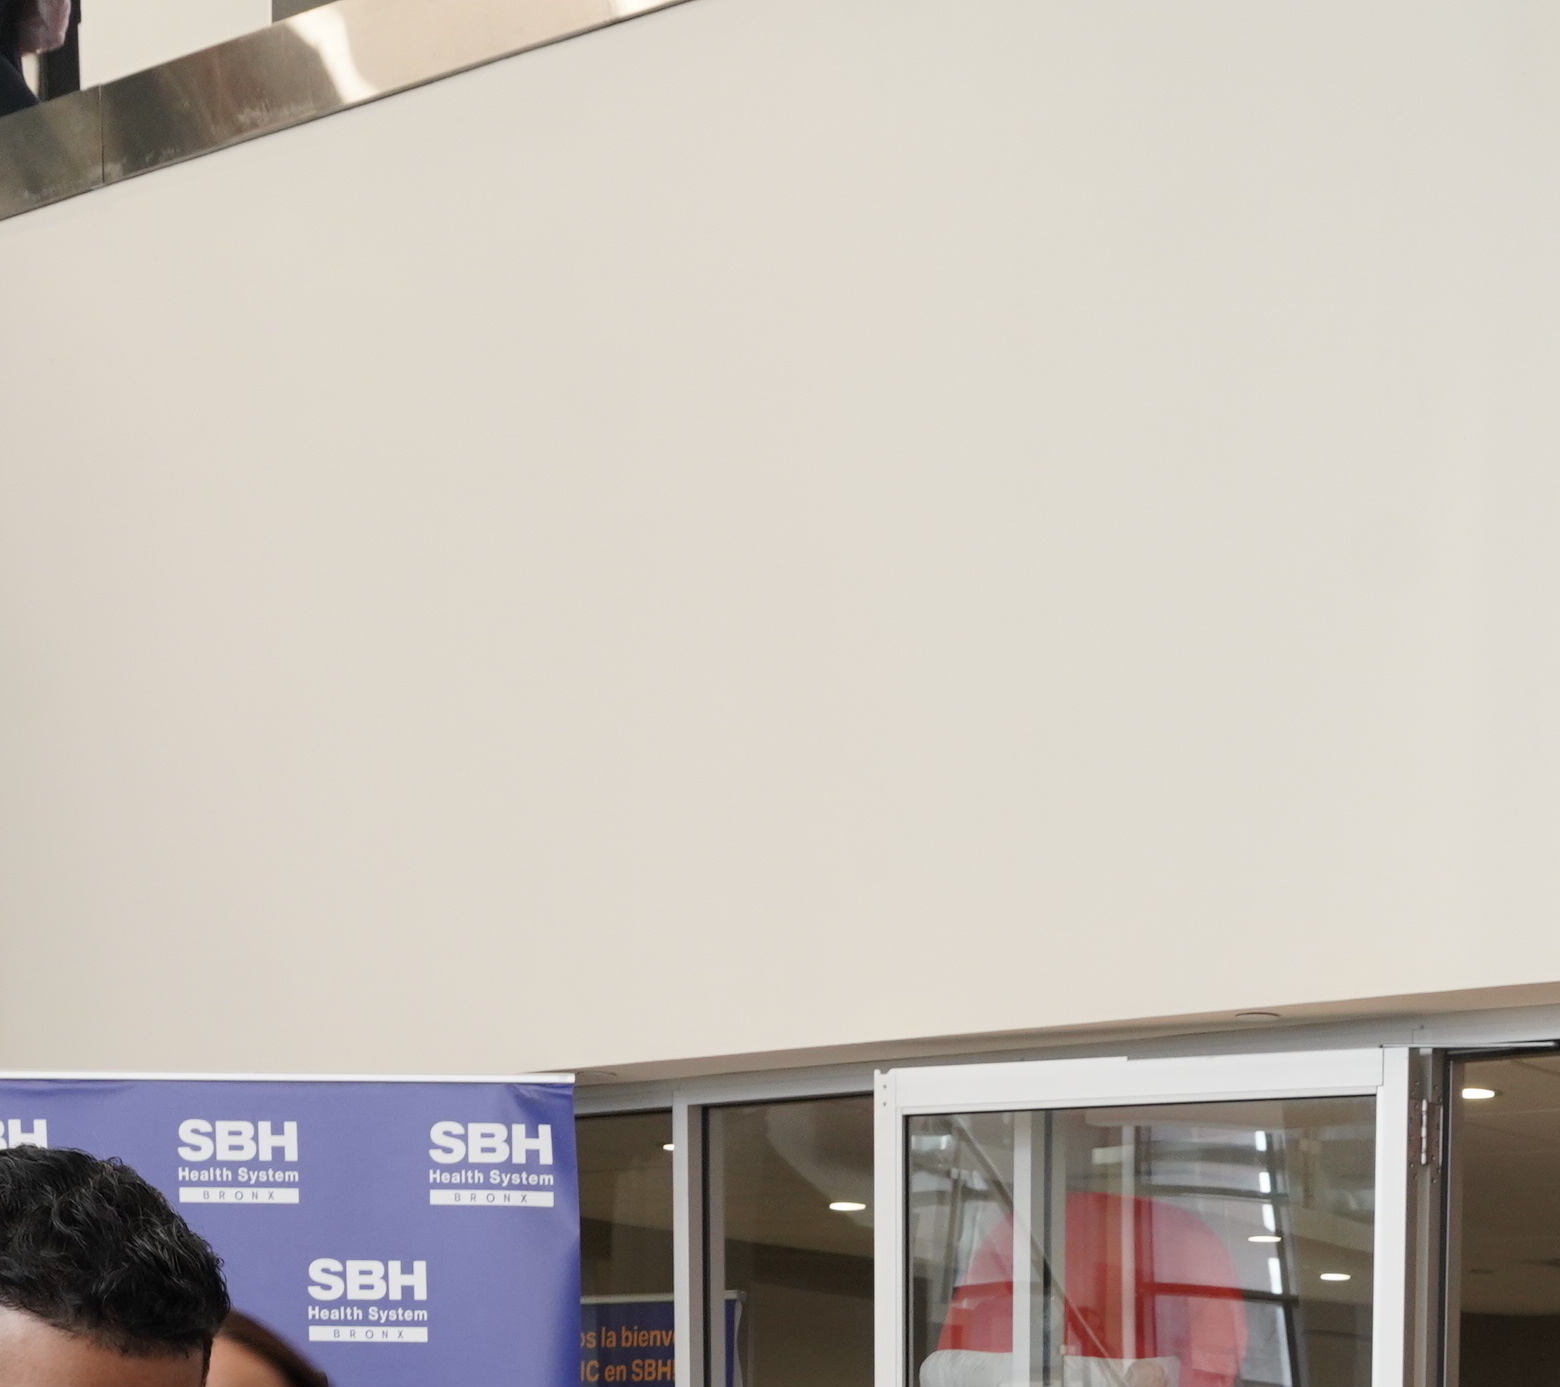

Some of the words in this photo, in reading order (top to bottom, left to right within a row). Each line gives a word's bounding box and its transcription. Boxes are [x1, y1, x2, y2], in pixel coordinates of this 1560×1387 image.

[177, 1119, 299, 1162] SBH
[428, 1120, 553, 1165] SBH
[178, 1167, 234, 1182] Health
[238, 1167, 300, 1186] System
[429, 1168, 486, 1185] Health
[490, 1170, 554, 1188] System
[202, 1189, 276, 1201] BRONX
[453, 1192, 529, 1203] BRONX
[307, 1258, 428, 1301] SBH
[308, 1306, 363, 1321] Health
[368, 1307, 428, 1323] System
[332, 1328, 405, 1340] BRONX
[600, 1326, 617, 1348] la
[604, 1364, 627, 1382] en
